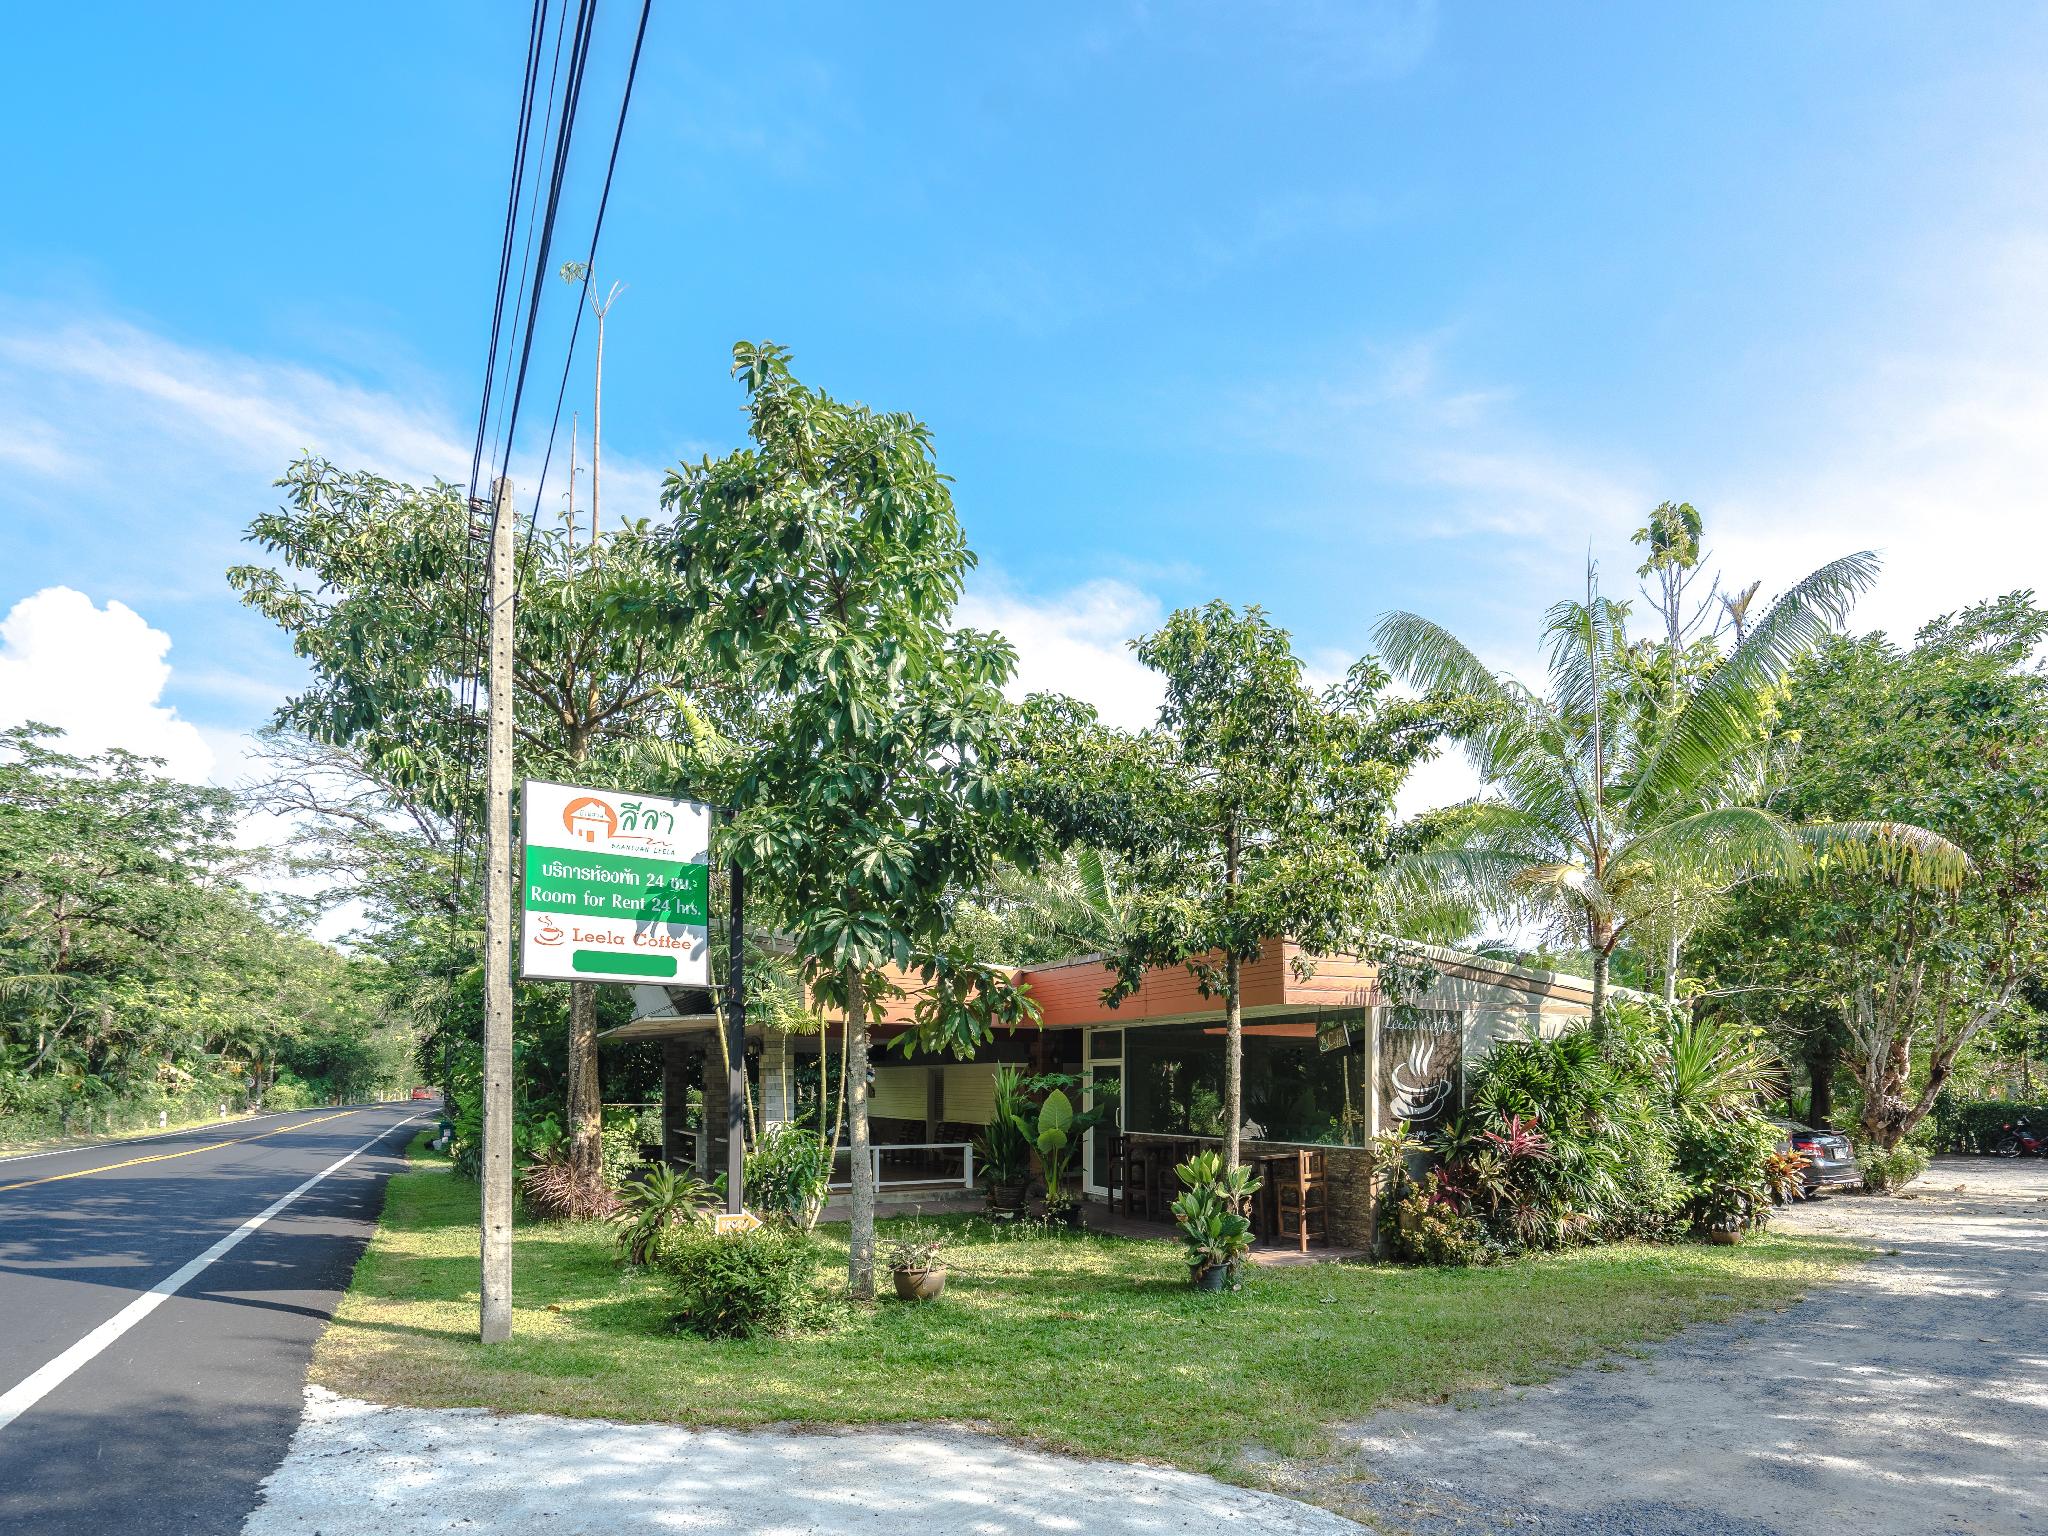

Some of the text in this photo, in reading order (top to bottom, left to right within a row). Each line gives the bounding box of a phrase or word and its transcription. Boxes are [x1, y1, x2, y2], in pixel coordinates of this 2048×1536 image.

[620, 802, 674, 835] ลีลา
[542, 860, 640, 886] บริการห้องพัก
[646, 872, 665, 888] 24
[531, 885, 702, 916] Room for Rent 24 hrs.
[572, 927, 692, 950] Leela Coffee
[1421, 1016, 1458, 1037] Coffee
